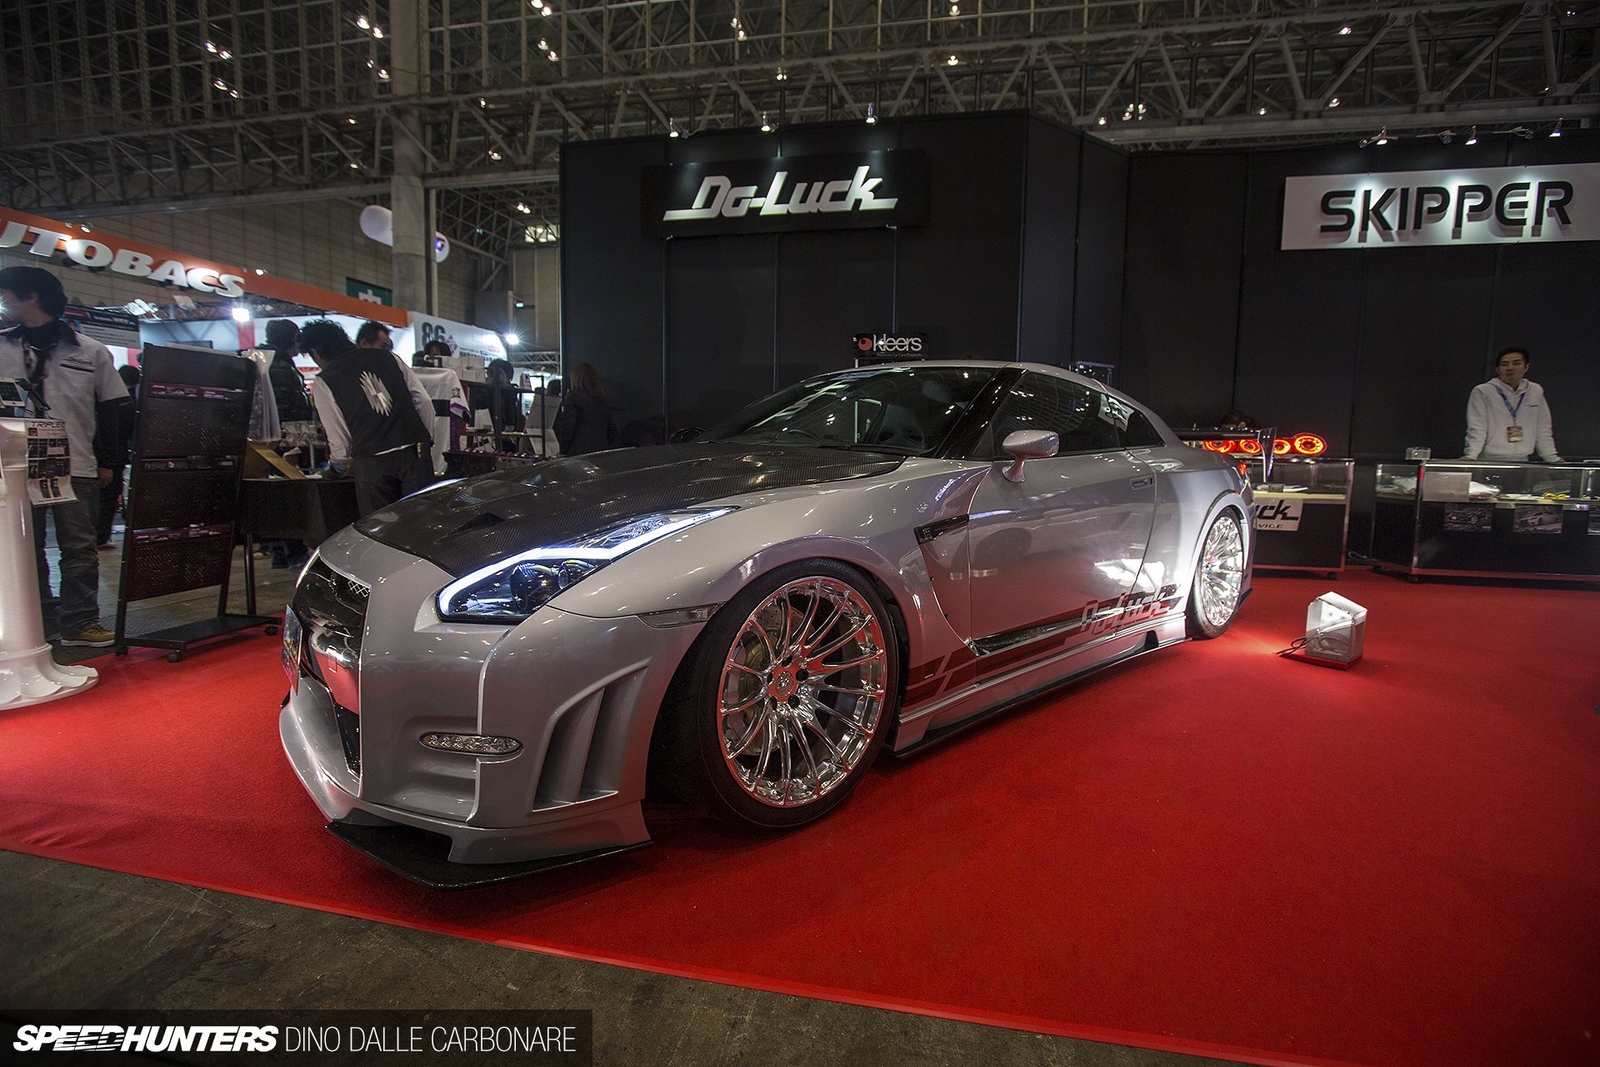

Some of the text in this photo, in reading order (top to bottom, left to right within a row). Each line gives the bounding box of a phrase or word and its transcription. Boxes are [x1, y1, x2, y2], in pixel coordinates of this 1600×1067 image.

[663, 166, 898, 221] Do-Luck
[1320, 180, 1574, 234] SKIPPER
[873, 333, 922, 351] kleers
